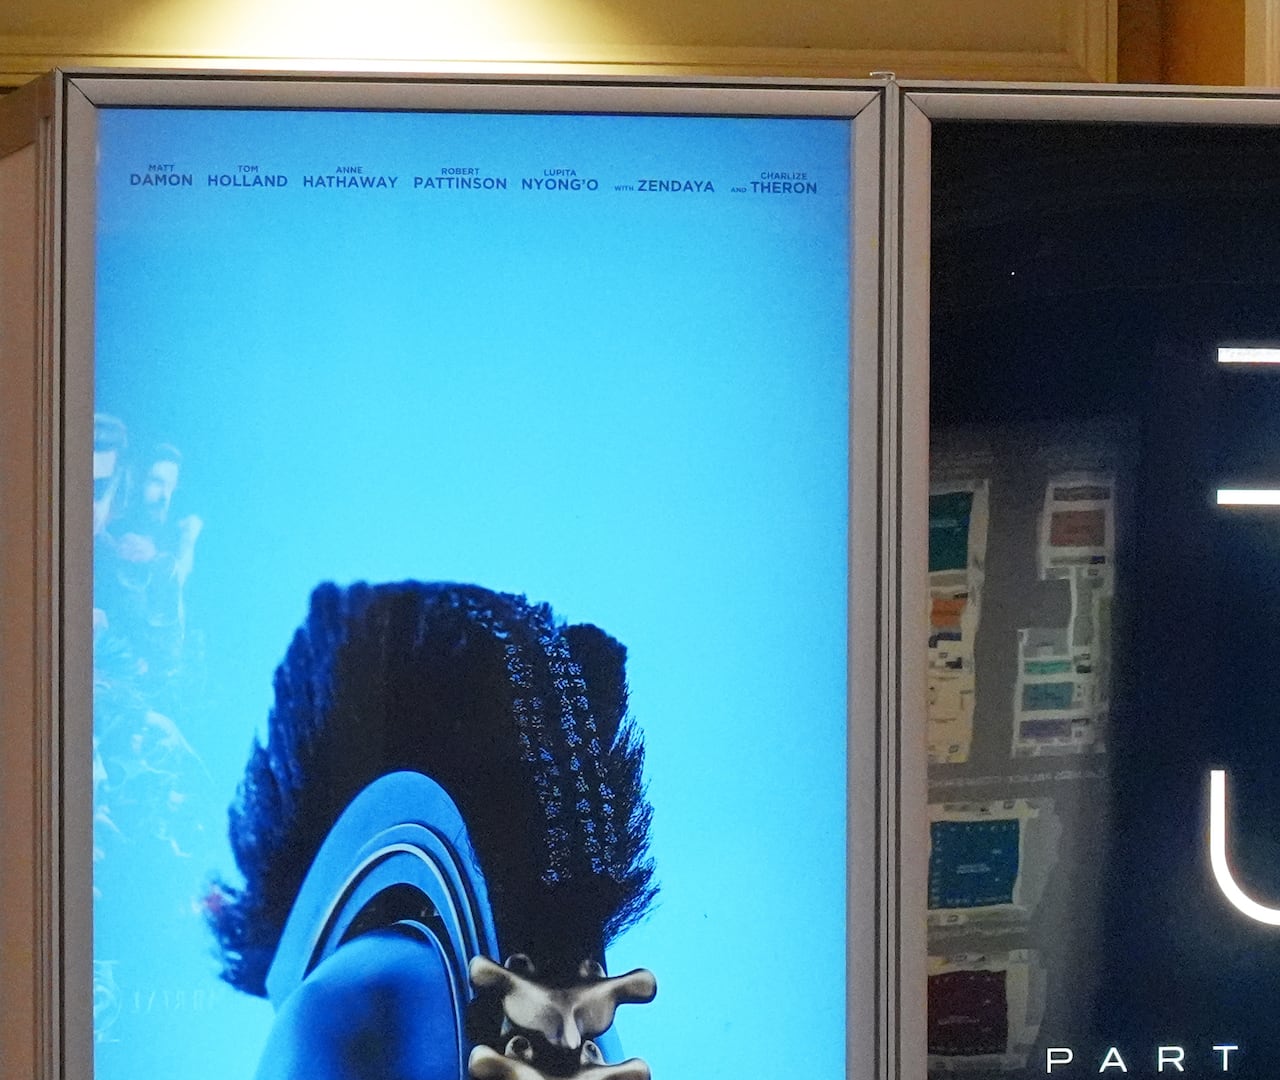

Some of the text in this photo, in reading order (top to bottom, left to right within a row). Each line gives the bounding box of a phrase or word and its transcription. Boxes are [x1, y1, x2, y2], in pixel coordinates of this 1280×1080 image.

[148, 164, 175, 172] MATT
[238, 165, 259, 173] TOM
[336, 166, 364, 174] ANNE
[441, 168, 480, 176] ROBERT
[544, 169, 576, 177] LUPITA
[130, 174, 193, 186] DAMON
[208, 174, 288, 188] HOLLAND
[303, 175, 398, 188] HATHAWAY
[760, 172, 808, 181] CHARLIZE
[414, 177, 508, 190] PATTINSON
[521, 178, 598, 191] NYONG'O
[637, 180, 715, 193] ZENDAYA
[750, 181, 818, 194] THERON
[1046, 1045, 1241, 1075] PART
